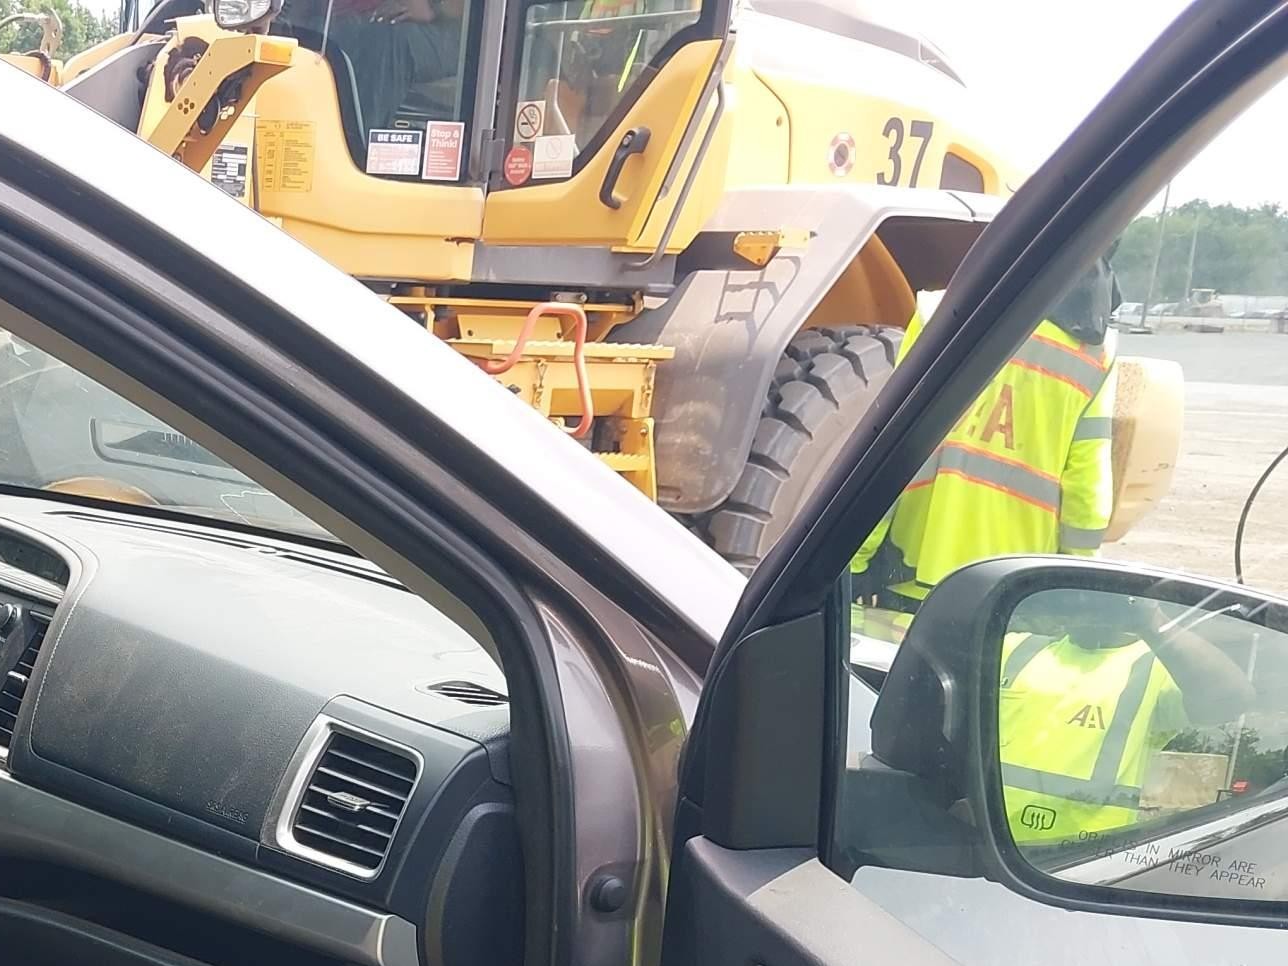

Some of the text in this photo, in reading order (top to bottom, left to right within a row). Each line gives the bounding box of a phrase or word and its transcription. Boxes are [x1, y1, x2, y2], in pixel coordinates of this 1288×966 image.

[377, 133, 413, 143] BE SAFE
[430, 128, 460, 139] Stop &
[431, 138, 458, 148] Think!
[876, 117, 934, 188] 37
[1146, 843, 1161, 855] IN
[1168, 847, 1222, 867] MIRROR
[1228, 859, 1257, 875] ARE
[1123, 851, 1159, 867] THAN
[1168, 861, 1204, 876] THEY
[1210, 869, 1266, 889] APPEAR
